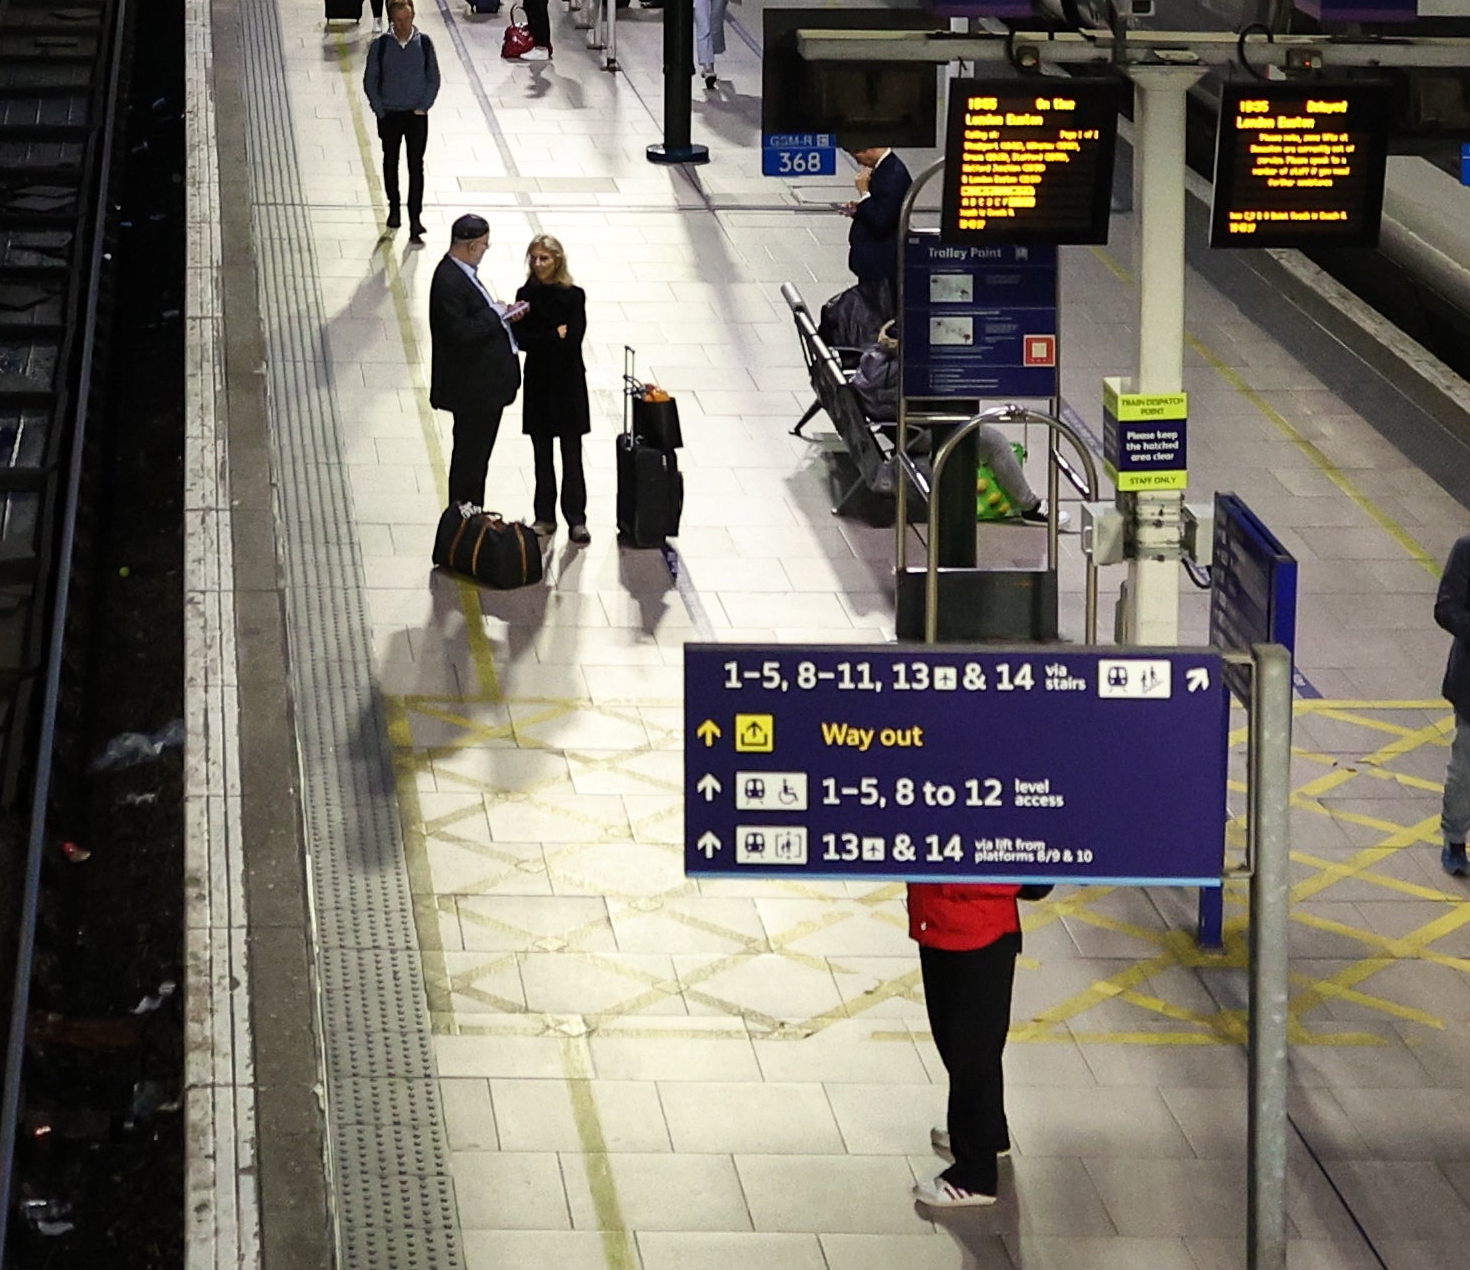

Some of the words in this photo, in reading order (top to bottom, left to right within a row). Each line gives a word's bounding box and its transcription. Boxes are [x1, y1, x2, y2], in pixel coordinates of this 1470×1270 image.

[1306, 99, 1349, 114] Delayed
[965, 113, 1005, 127] London
[1005, 113, 1044, 127] Euston
[1236, 115, 1276, 129] London
[1276, 115, 1316, 129] Euston
[778, 151, 821, 173] 368
[928, 247, 967, 260] Trolley
[969, 247, 1002, 259] Point
[1121, 398, 1146, 407] TRAIN
[1146, 397, 1184, 406] DISPATCH
[1140, 407, 1164, 416] POINT
[1126, 430, 1155, 441] Please
[1156, 430, 1178, 441] keep
[1125, 442, 1142, 451] the
[1143, 440, 1179, 451] hatched
[1130, 453, 1151, 462] area
[1152, 452, 1175, 461] clear
[1129, 477, 1152, 485] STAFF
[1153, 476, 1177, 484] ONLY
[892, 663, 930, 691] 13
[963, 663, 988, 691] &
[995, 662, 1035, 691] 14
[1045, 664, 1067, 678] via
[1045, 677, 1087, 691] stairs
[820, 722, 875, 753] Way
[879, 725, 924, 748] out
[895, 778, 915, 807] 8
[923, 780, 956, 807] to
[964, 778, 1003, 807] 12
[1014, 778, 1050, 794] level
[1014, 794, 1064, 809] access
[821, 833, 860, 863] 13
[891, 833, 917, 862] &
[924, 833, 963, 863] 14
[975, 840, 994, 852] via
[996, 839, 1015, 852] lift
[1016, 839, 1046, 853] from
[974, 849, 1035, 864] platforms
[1036, 849, 1061, 863] 8/9
[1062, 850, 1076, 863] &
[1078, 850, 1093, 863] 10
